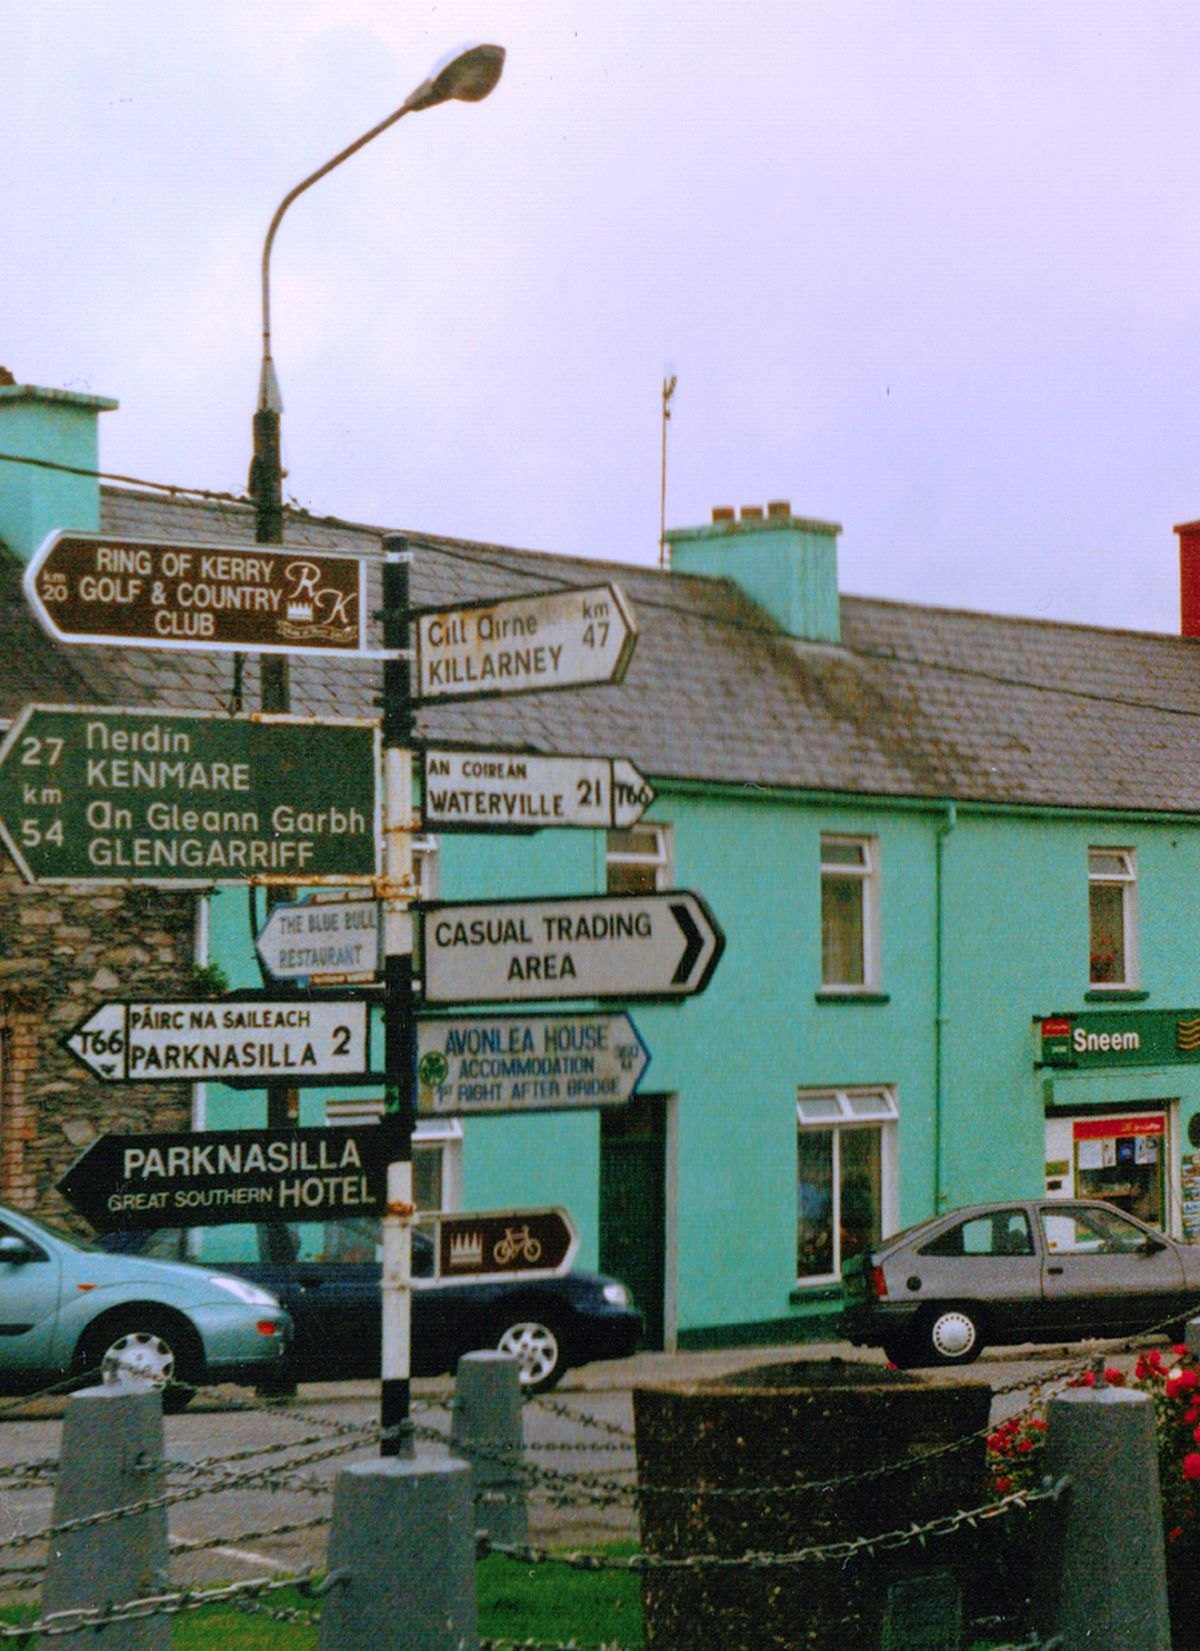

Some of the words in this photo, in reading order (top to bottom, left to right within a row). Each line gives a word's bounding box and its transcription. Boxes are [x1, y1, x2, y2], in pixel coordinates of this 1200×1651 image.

[97, 548, 150, 575] RING
[162, 552, 191, 577] OF
[201, 556, 275, 582] KERRY
[43, 584, 68, 602] 20
[80, 577, 142, 602] GOLF
[151, 583, 166, 605] &
[177, 584, 282, 611] COUNTRY
[582, 599, 609, 618] km
[155, 611, 215, 637] CLUB
[428, 620, 466, 647] Cill
[477, 613, 538, 640] Airne
[582, 622, 610, 648] 47
[428, 645, 563, 685] KILLARNEY
[21, 737, 65, 766] 27
[87, 760, 250, 790] KENMARE
[428, 759, 450, 776] AN
[24, 784, 62, 804] km
[429, 789, 564, 816] WATERVILLE
[576, 779, 601, 806] 21
[86, 800, 132, 830] An
[147, 802, 259, 832] Gleann
[272, 805, 365, 834] Garbh
[21, 819, 65, 847] 54
[88, 838, 314, 867] GLENGARRIFF
[280, 914, 303, 935] THE
[308, 912, 340, 933] BLUE
[344, 909, 377, 931] BULL
[435, 919, 532, 947] CASUAL
[543, 913, 653, 939] TRADING
[279, 944, 363, 969] RESTAURANT
[507, 954, 576, 981] AREA
[130, 1007, 184, 1030] PÁIRC
[190, 1011, 217, 1030] NA
[223, 1010, 310, 1029] SAILEACH
[78, 1030, 124, 1055] T66
[332, 1025, 351, 1056] 2
[445, 1027, 534, 1056] AVONLEA
[545, 1024, 608, 1051] HOUSE
[1073, 1027, 1140, 1052] Sneem
[130, 1042, 317, 1070] PARKNASILLA
[459, 1057, 594, 1079] ACCOMMODATION
[458, 1084, 501, 1101] RIGHT
[512, 1081, 559, 1099] AFTER
[123, 1139, 362, 1179] PARKNASILLA
[108, 1191, 169, 1212] GREAT
[175, 1187, 273, 1209] SOUTHERN
[279, 1176, 376, 1208] HOTEL
